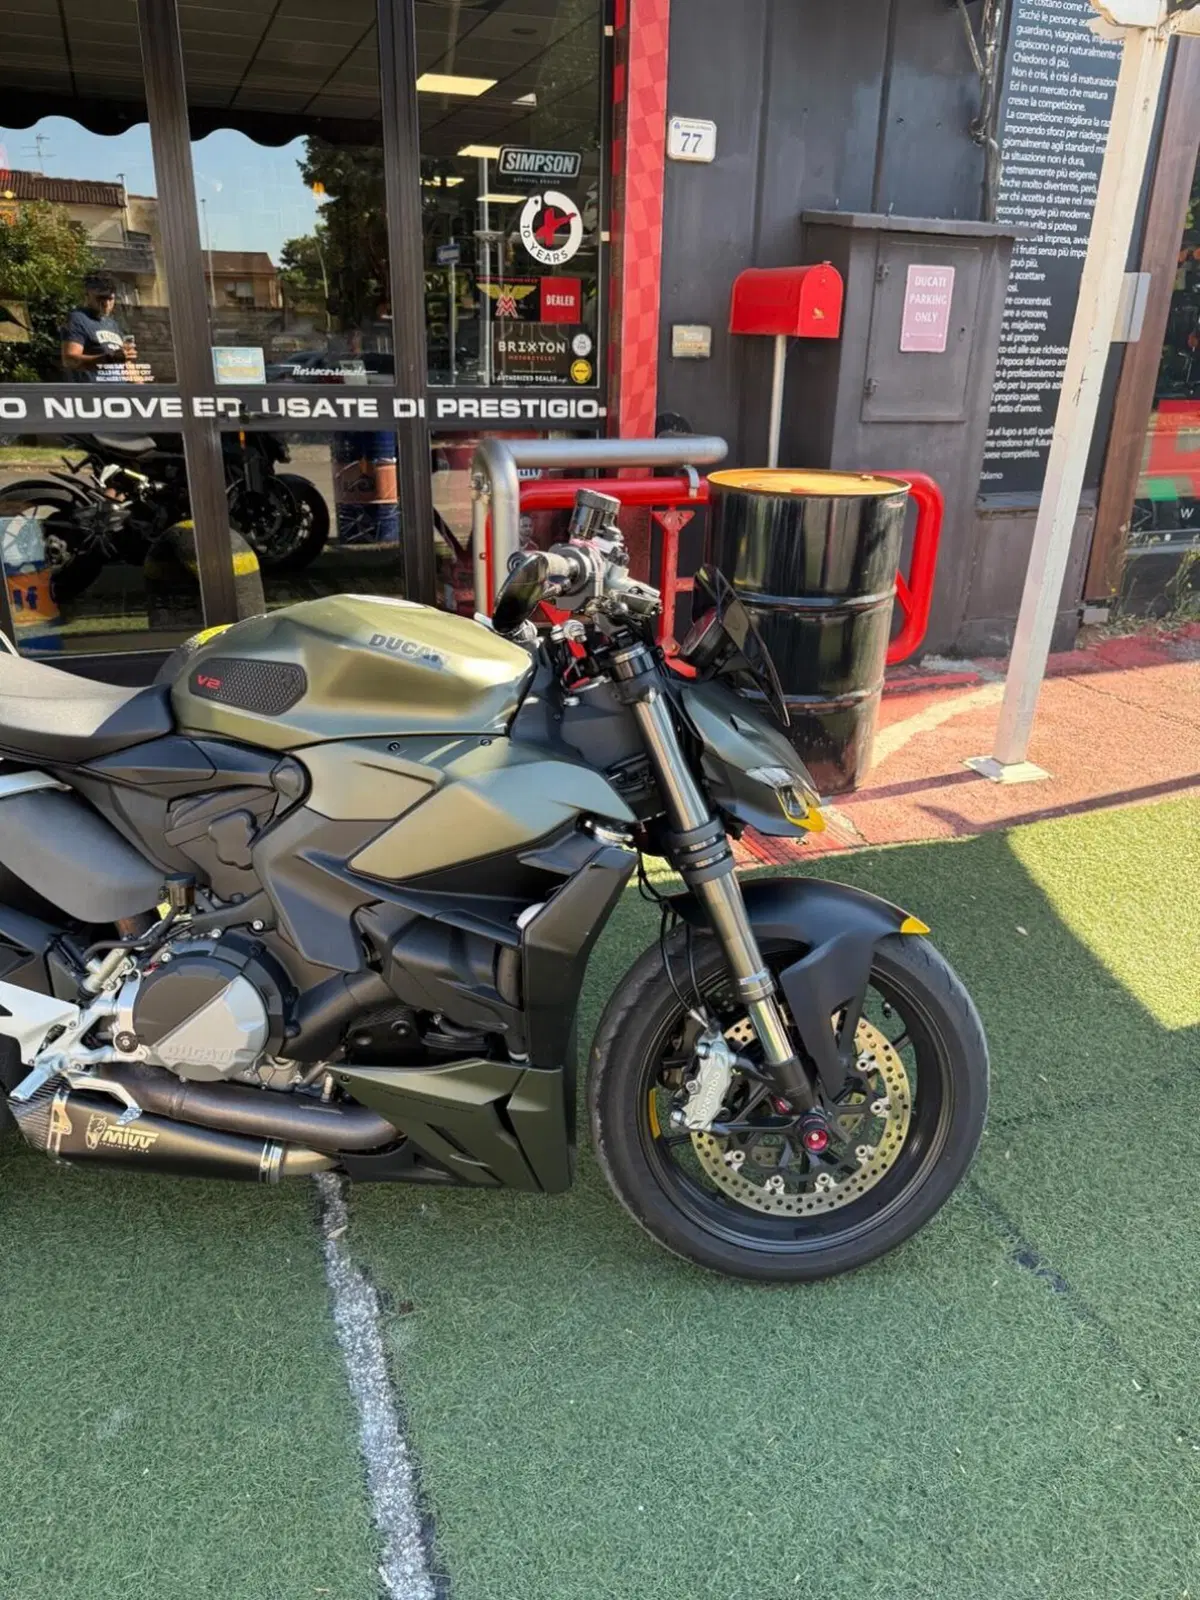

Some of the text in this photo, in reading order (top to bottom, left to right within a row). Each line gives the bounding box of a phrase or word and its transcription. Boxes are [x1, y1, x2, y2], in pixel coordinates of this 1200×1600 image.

[1063, 2, 1082, 11] come
[1018, 8, 1040, 21] Sicché
[1049, 16, 1078, 25] persone
[1016, 26, 1052, 38] guardano,
[1014, 40, 1049, 52] capiscono
[1056, 44, 1068, 54] poi
[1070, 46, 1116, 59] naturalmente
[1013, 52, 1048, 66] Chiedono
[1049, 57, 1056, 66] di
[1012, 67, 1026, 77] Non
[1056, 72, 1070, 82] crisi
[1070, 73, 1078, 82] di
[1010, 80, 1019, 91] Ed
[1021, 82, 1028, 92] in
[1040, 86, 1068, 96] mercato
[1070, 88, 1082, 98] che
[1083, 90, 1108, 100] matura
[1008, 96, 1030, 106] cresce
[1038, 99, 1086, 112] competizione.
[1006, 109, 1015, 119] La
[1016, 111, 1063, 123] competizione
[1064, 114, 1092, 127] migliora
[1004, 122, 1046, 136] imponendo
[1047, 127, 1066, 138] sforzi
[1066, 130, 1078, 140] per
[681, 132, 703, 153] 77
[1003, 138, 1050, 150] giornalmente
[1051, 142, 1064, 152] agli
[1065, 143, 1095, 154] standard
[506, 152, 574, 173] SIMPSON
[1002, 150, 1010, 160] La
[1011, 152, 1046, 164] situazione
[1048, 156, 1060, 164] non
[1006, 166, 1056, 177] estremamente
[1056, 168, 1068, 180] più
[1068, 171, 1098, 182] esigente.
[1022, 180, 1042, 190] molto
[1010, 192, 1020, 201] chi
[1021, 194, 1045, 202] accetta
[1046, 194, 1053, 204] di
[1054, 197, 1070, 205] stare
[1072, 197, 1082, 206] nel
[1024, 208, 1046, 218] regole
[1047, 208, 1058, 218] più
[1054, 222, 1078, 232] poteva
[522, 224, 569, 262] 10 YEARS
[1020, 245, 1037, 255] frutti
[1038, 248, 1057, 256] senza
[1058, 248, 1070, 258] più
[914, 276, 947, 287] DUCATI
[1014, 272, 1046, 281] accettare
[546, 294, 575, 306] DEALER
[909, 294, 948, 304] PARKING
[915, 312, 938, 322] ONLY
[1014, 333, 1039, 344] proprio
[498, 341, 566, 354] BRIXTON
[1008, 344, 1016, 354] ed
[1018, 344, 1028, 354] alle
[1025, 356, 1036, 366] del
[1036, 356, 1056, 366] lavoro
[1007, 368, 1055, 379] professionismo
[993, 380, 1006, 392] glio
[1008, 382, 1019, 391] per
[1027, 380, 1051, 391] propria
[995, 392, 1019, 402] proprio
[0, 398, 27, 418] O
[43, 397, 184, 418] NUOVE
[261, 398, 378, 418] USATE
[394, 398, 425, 418] DI
[997, 404, 1013, 413] fatto
[1002, 427, 1016, 437] lupo
[1023, 427, 1038, 436] tutti
[996, 438, 1022, 448] credono
[1024, 438, 1034, 446] nel
[369, 633, 443, 661] DUCA
[198, 675, 221, 689] V2
